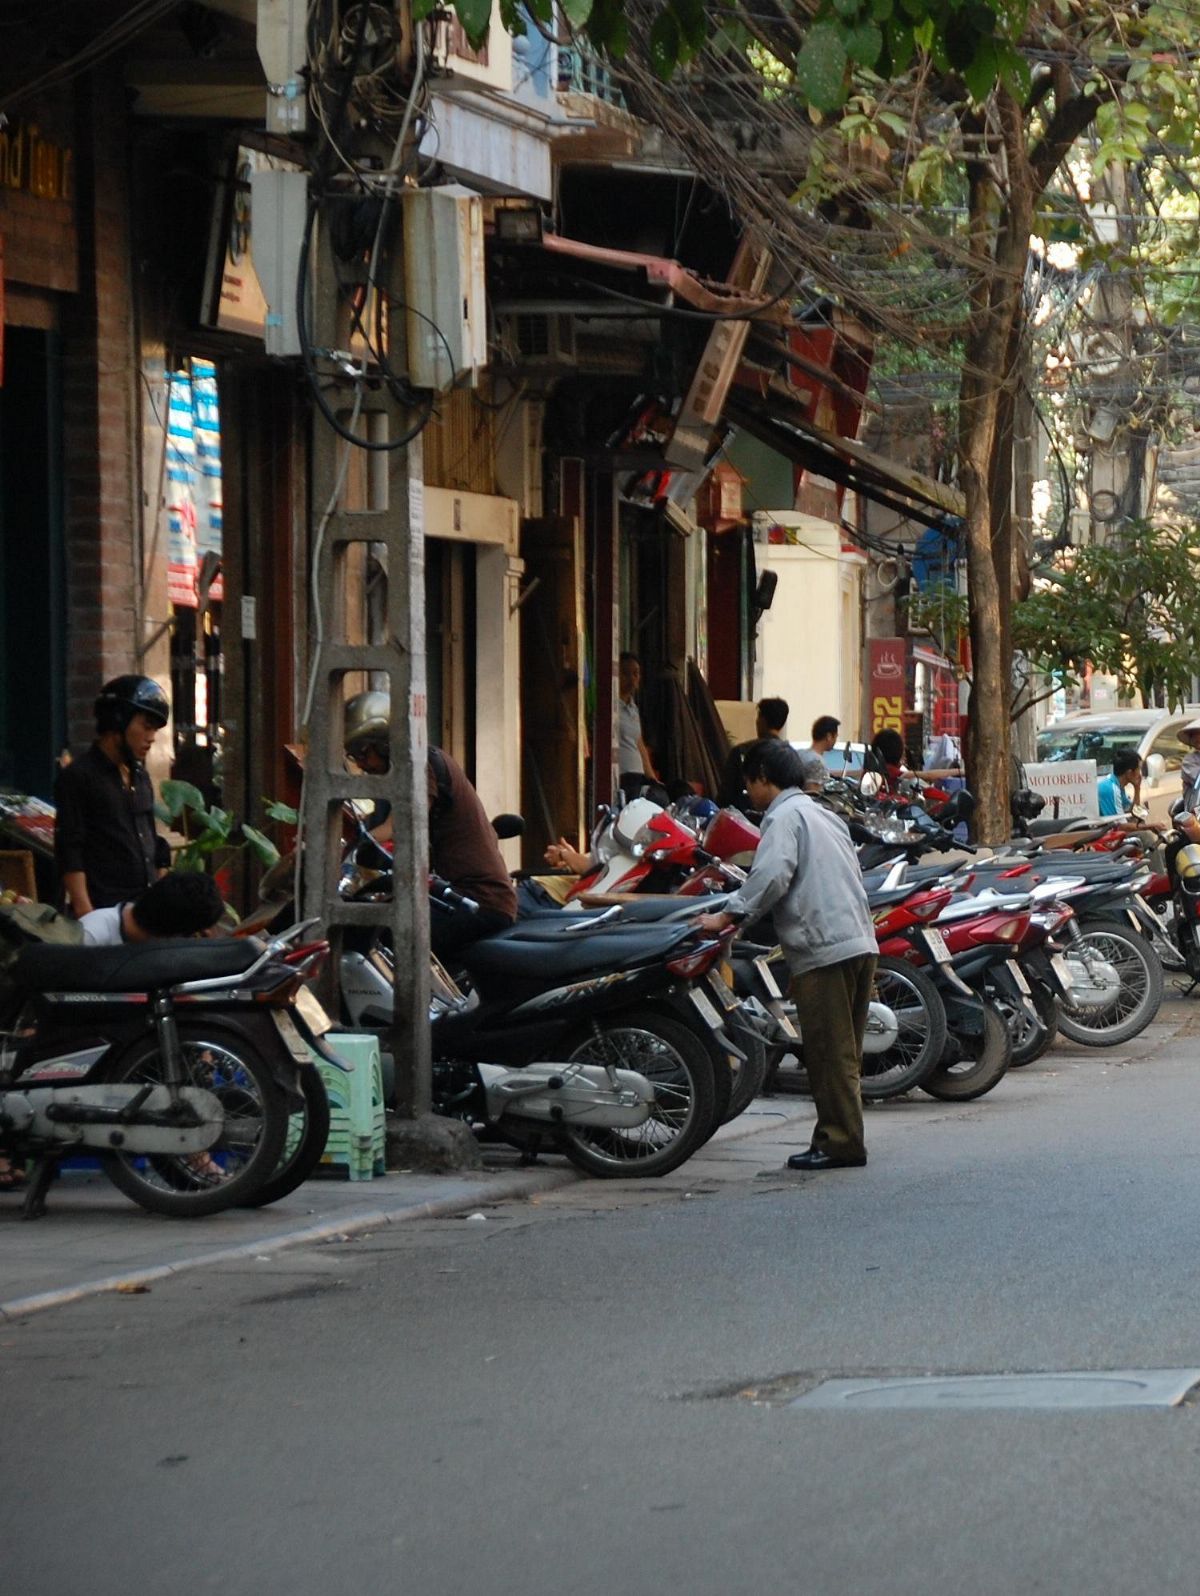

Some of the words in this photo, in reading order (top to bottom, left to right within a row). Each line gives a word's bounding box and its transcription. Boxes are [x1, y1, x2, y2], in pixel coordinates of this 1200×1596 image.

[1029, 772, 1092, 787] MOTORBIKE
[1059, 793, 1087, 806] SALE
[64, 994, 107, 1002] HONDA
